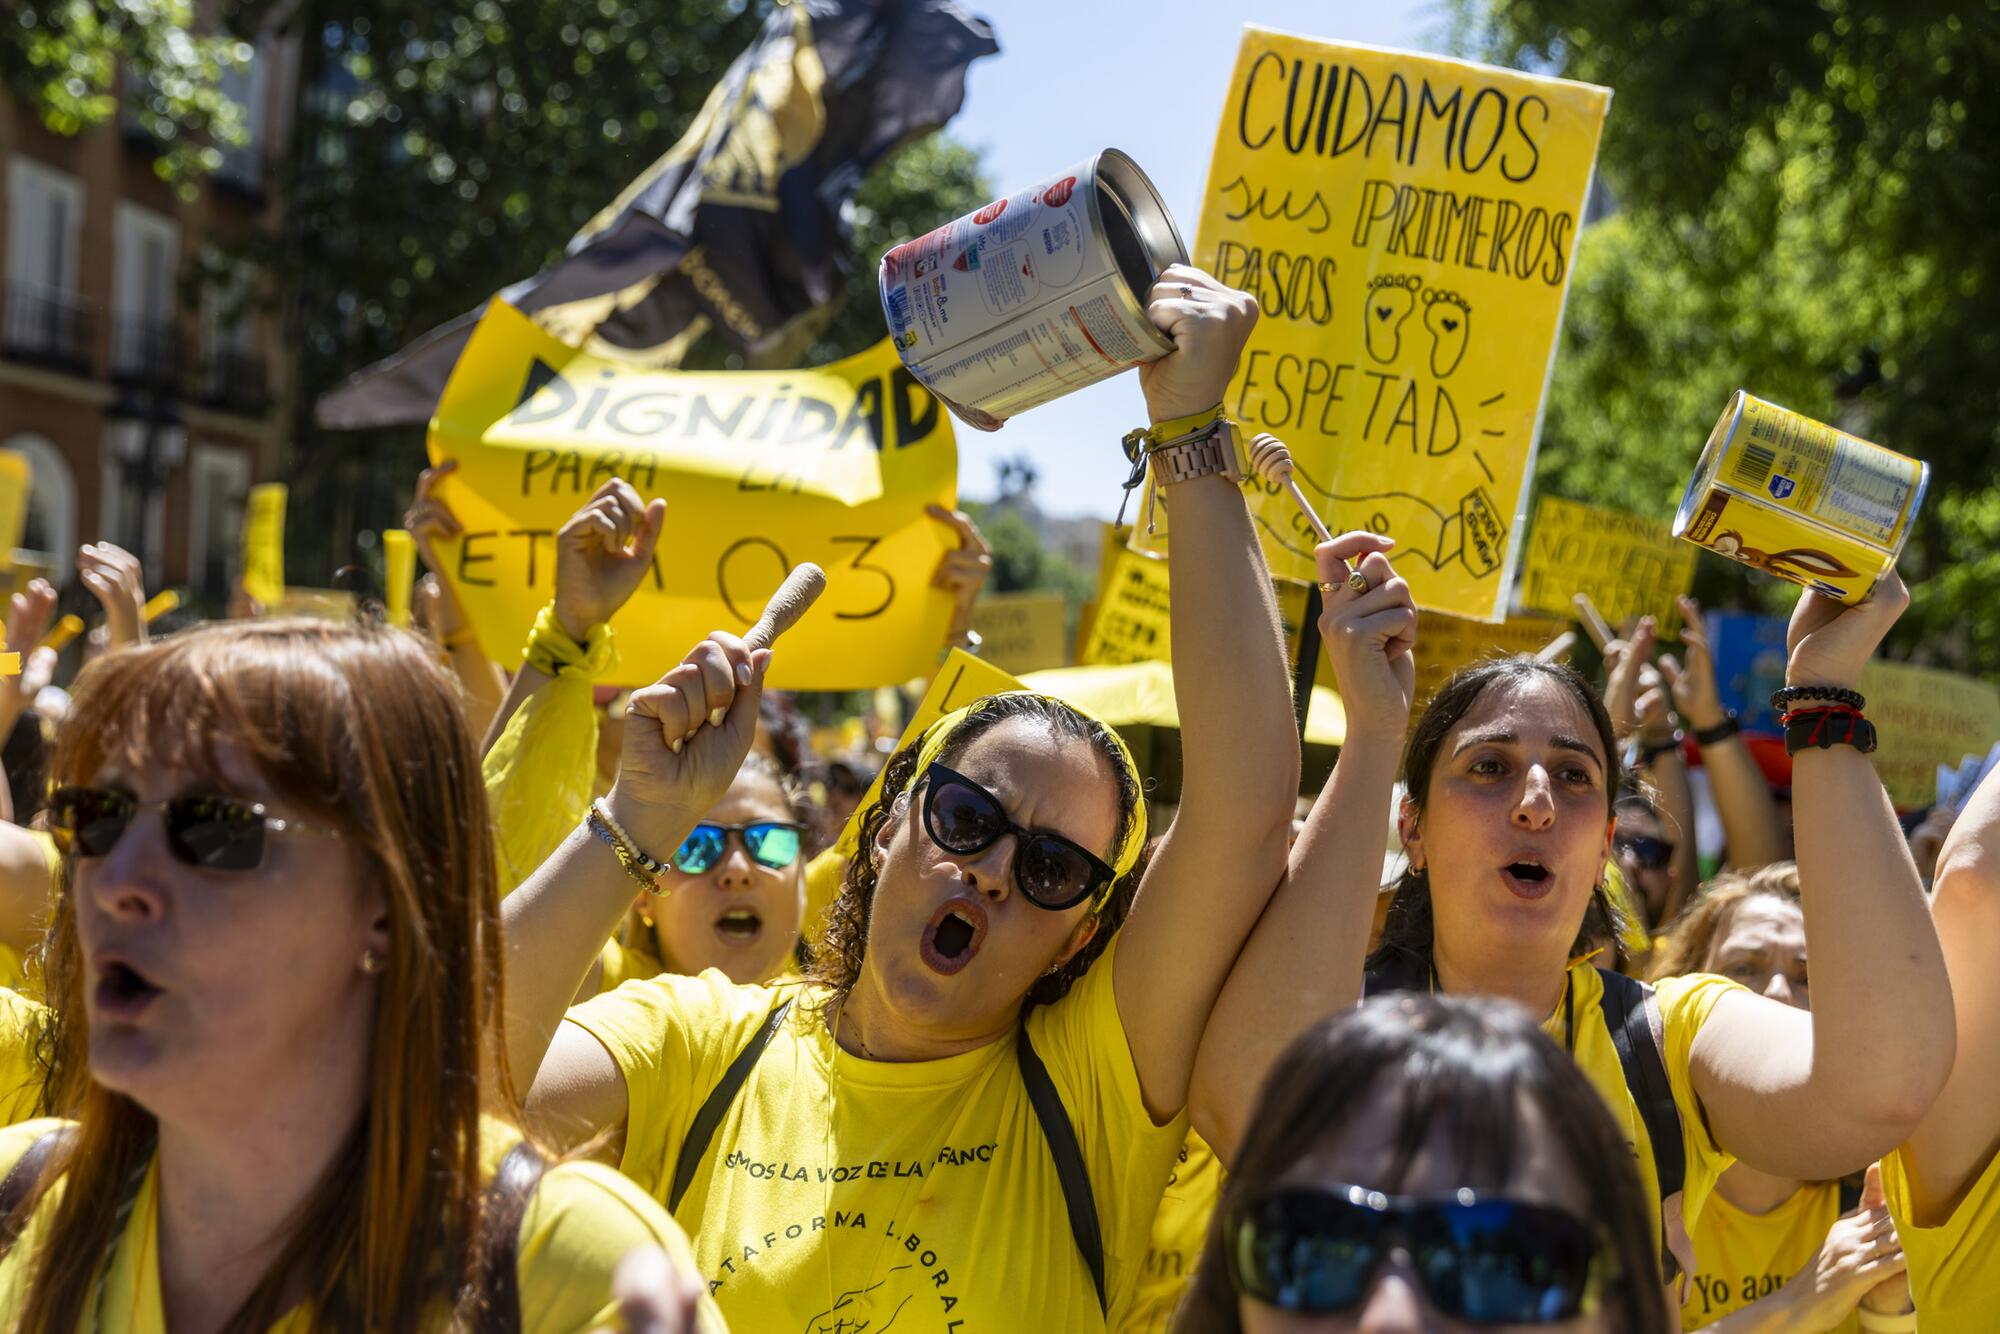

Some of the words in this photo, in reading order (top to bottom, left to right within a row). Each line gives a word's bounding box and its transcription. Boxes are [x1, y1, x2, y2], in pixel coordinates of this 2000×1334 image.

[1240, 51, 1549, 183] CUIDAMOS
[1219, 176, 1331, 233] sus
[1352, 180, 1572, 286] PRIMEROS
[1214, 241, 1336, 326] PASOS
[1237, 350, 1461, 457] ESPETAD
[522, 449, 659, 495] PARA
[738, 462, 803, 493] LA
[780, 1163, 808, 1182] LA
[817, 1165, 864, 1183] VOZ
[894, 1161, 923, 1178] LA
[1694, 1272, 1729, 1314] Yo
